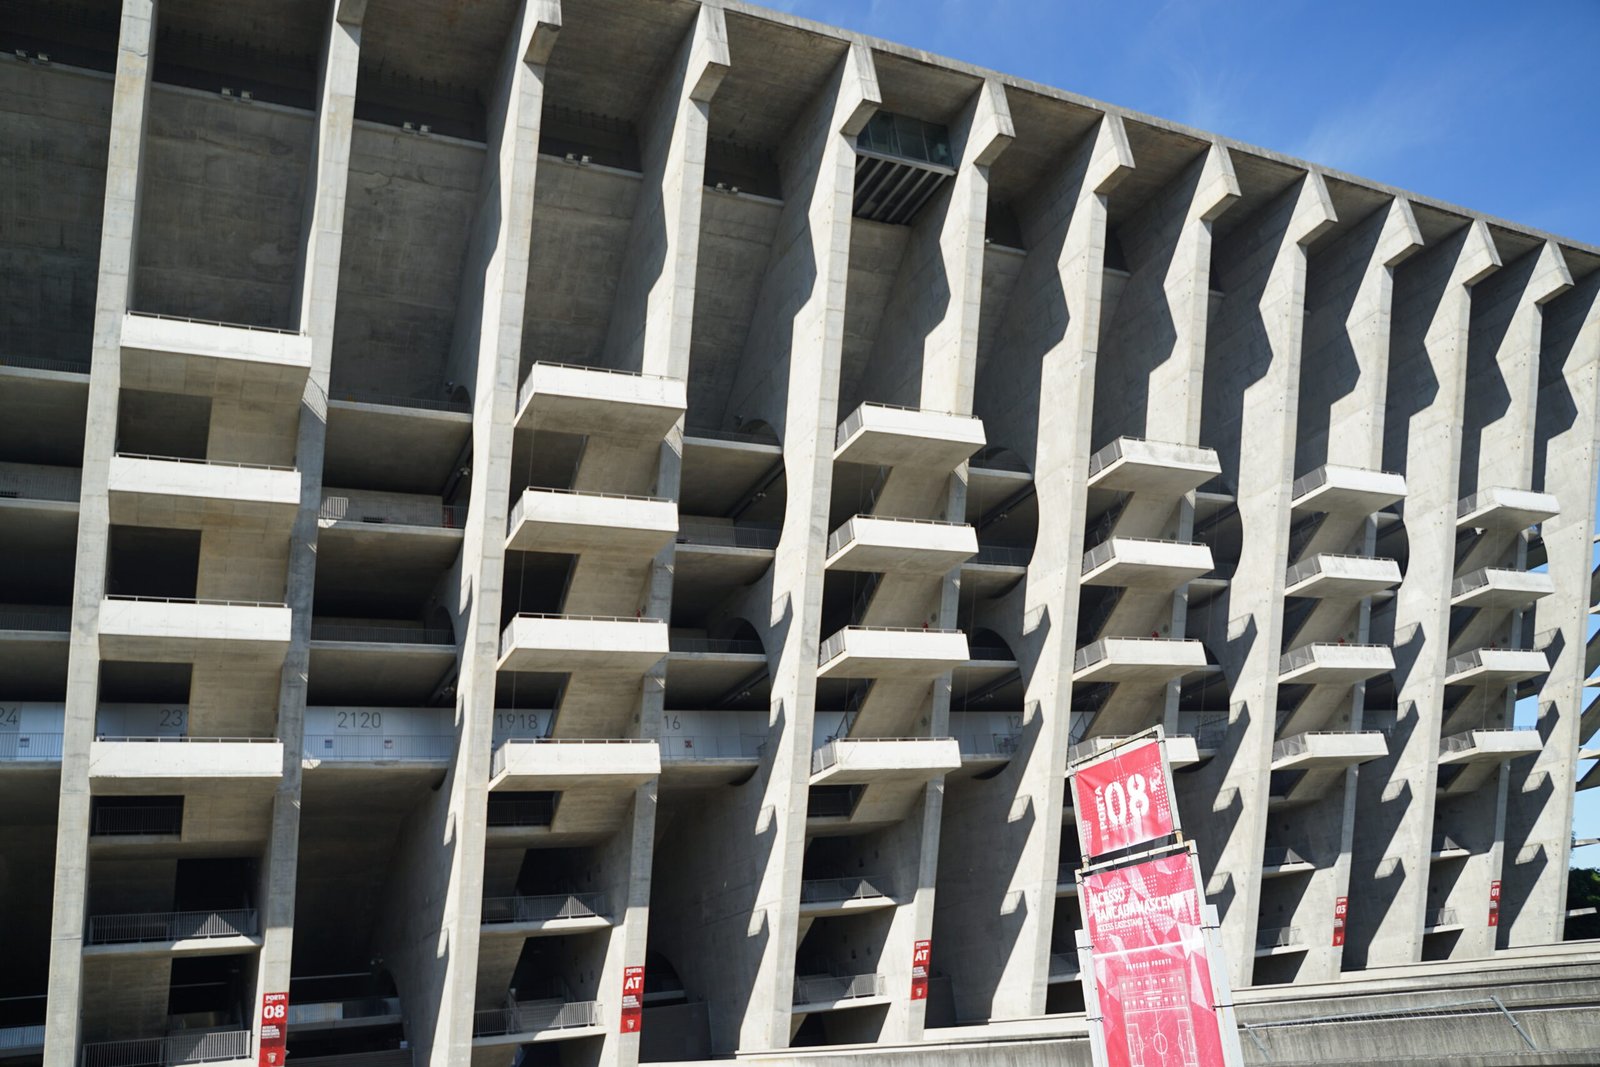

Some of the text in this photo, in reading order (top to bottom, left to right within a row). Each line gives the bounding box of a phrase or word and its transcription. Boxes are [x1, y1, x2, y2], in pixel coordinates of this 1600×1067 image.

[160, 708, 183, 727] 23
[663, 714, 681, 730] 16
[1007, 715, 1021, 729] 12
[1104, 773, 1149, 826] 08
[1094, 785, 1107, 830] PORTA
[914, 949, 929, 962] AT
[624, 976, 642, 990] AT
[263, 1004, 285, 1019] 08
